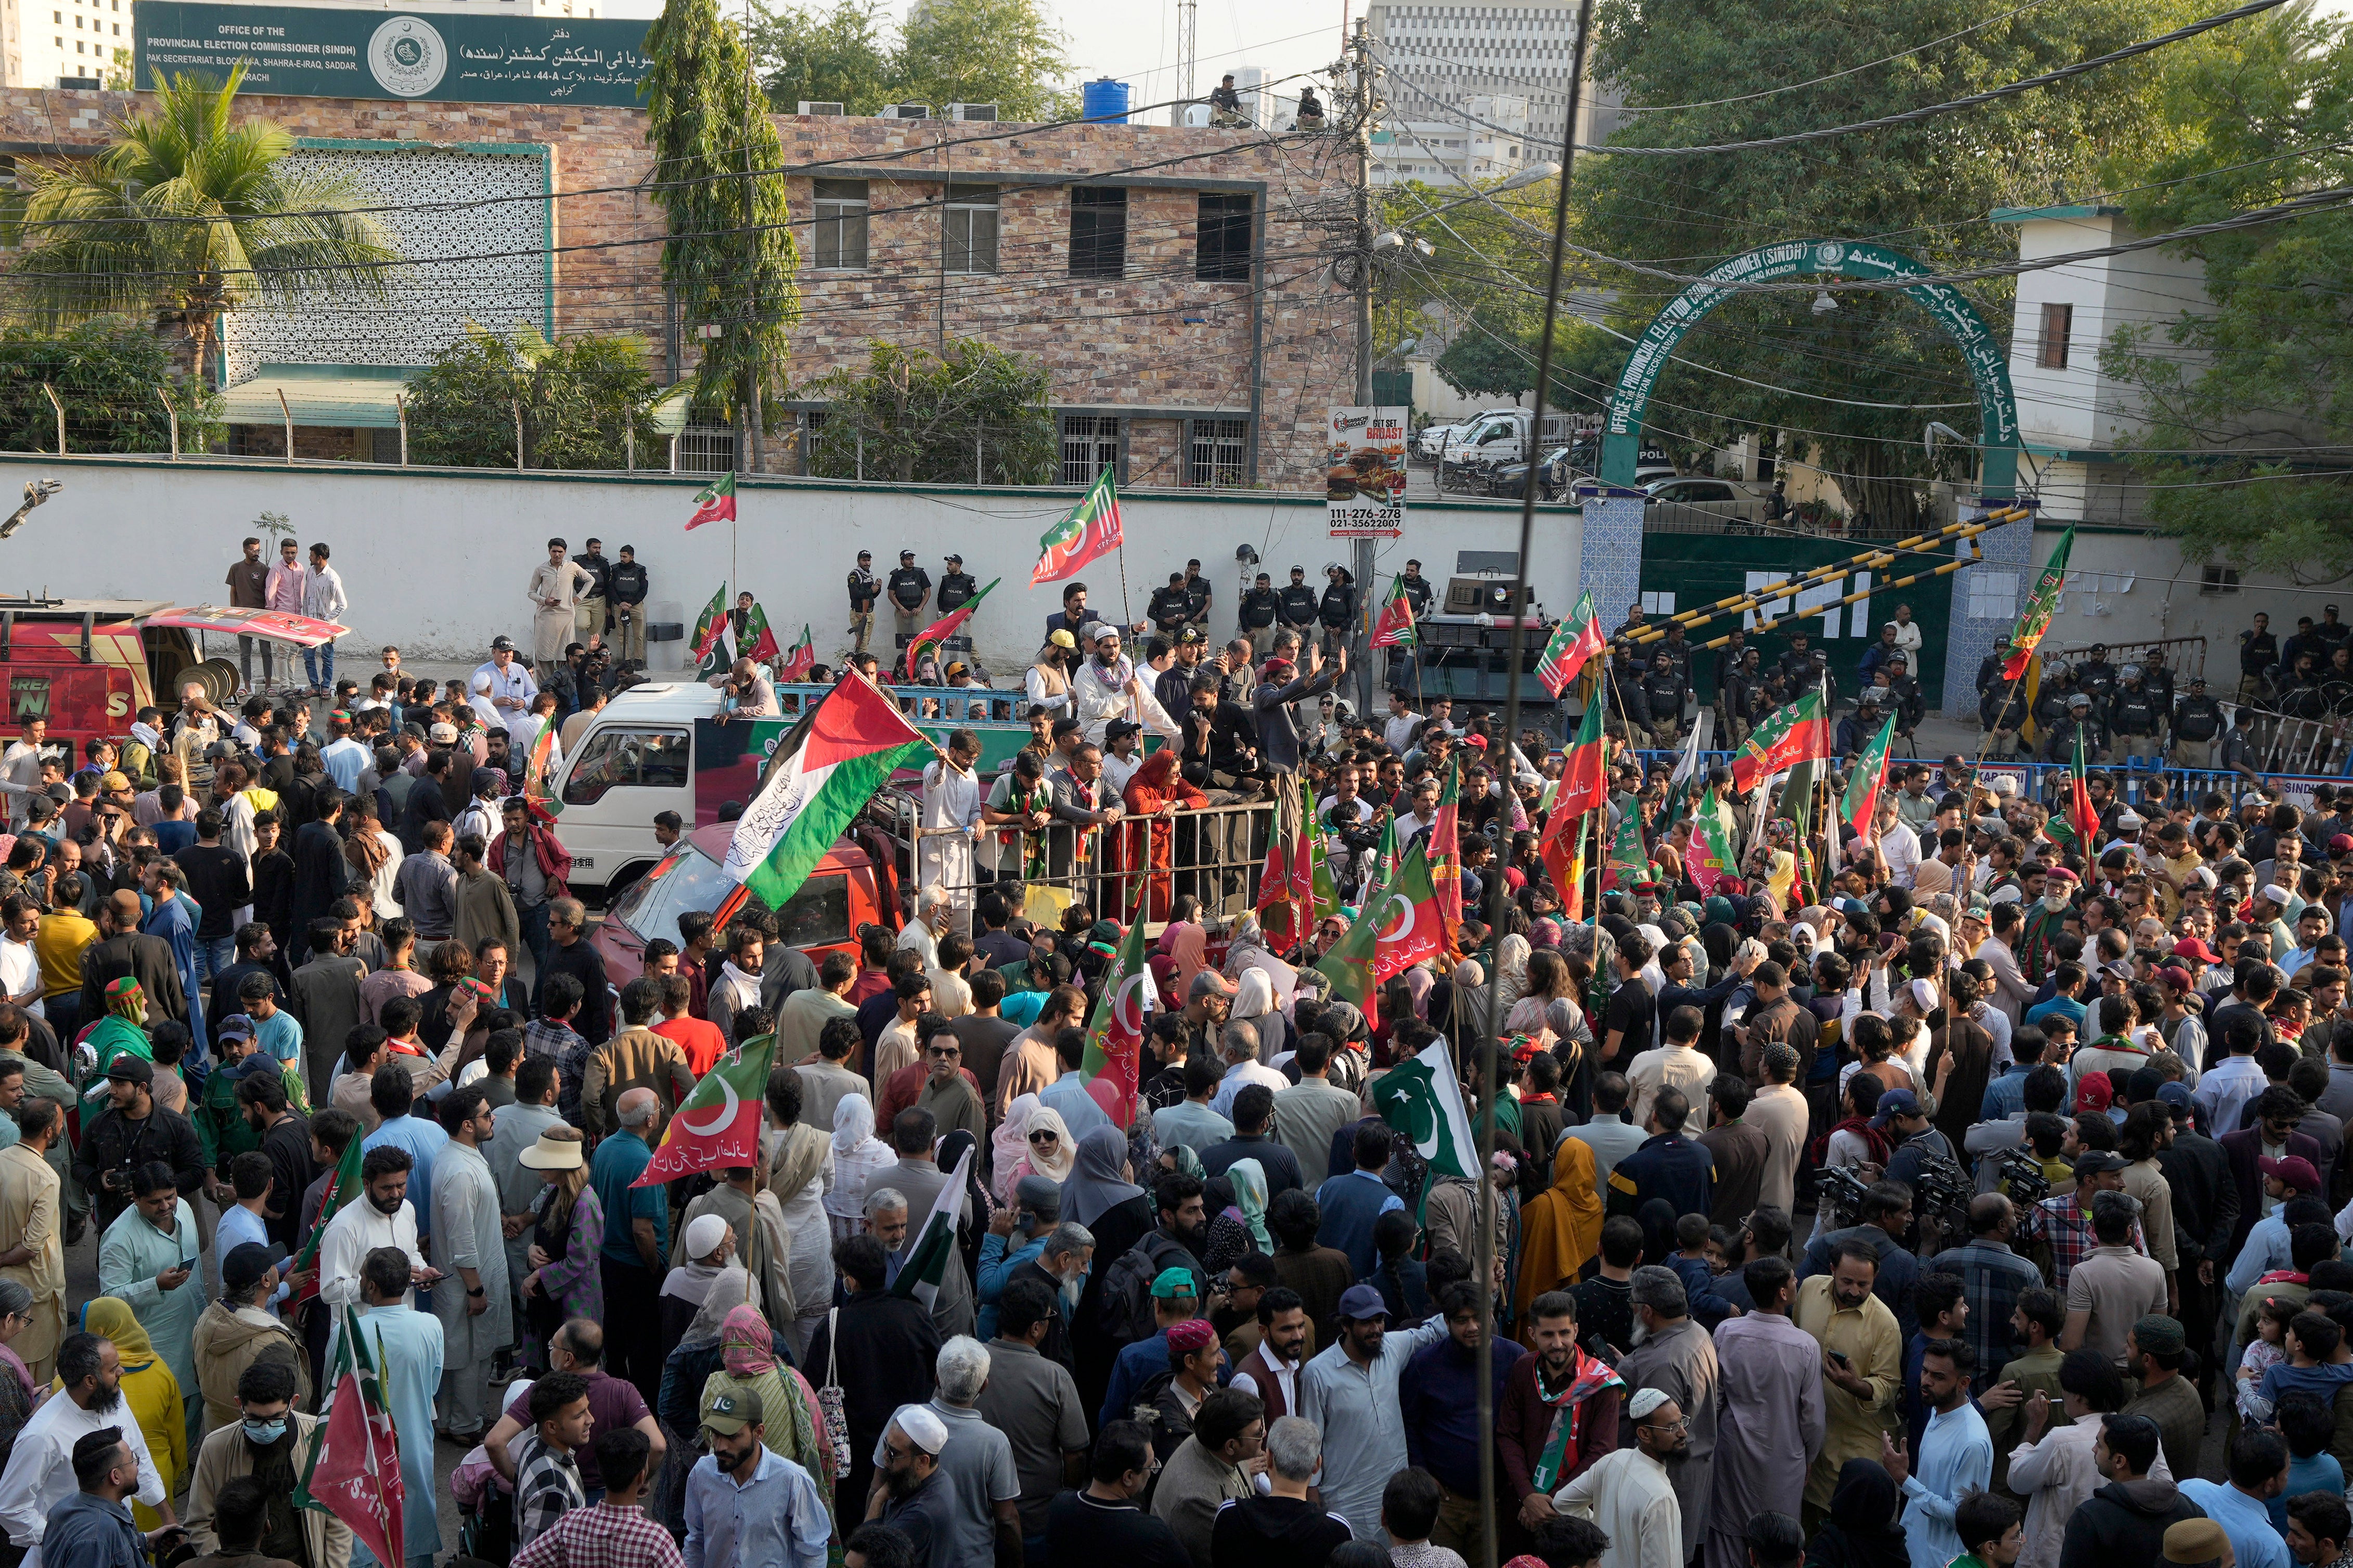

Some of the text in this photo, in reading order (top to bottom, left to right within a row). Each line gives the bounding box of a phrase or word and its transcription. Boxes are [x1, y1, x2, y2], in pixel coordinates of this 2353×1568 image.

[218, 25, 285, 36] OFFICE OF THE
[550, 28, 570, 41] دفتر
[147, 37, 356, 57] PROVINCIAL ELECTION COMMISSIONER (SINDH)
[146, 54, 161, 62] PAK
[163, 55, 214, 65] SECRETARIAT,
[216, 56, 242, 65] BLOCK
[263, 58, 323, 70] SHAHRA-E-IRAQ,
[325, 61, 357, 71] SADDAR,
[460, 70, 478, 79] صدر
[550, 83, 577, 97] کراچی
[1611, 399, 1631, 434] OFFICE
[1622, 339, 1660, 390] PROVINCIAL
[1762, 241, 1808, 267] (SINDH)
[1632, 377, 1652, 412] PAKISTAN
[1646, 330, 1679, 377] SECRETARIAT
[1765, 263, 1797, 278] KARACHI
[1346, 416, 1369, 424] KARACHI
[1386, 419, 1397, 427] SET
[1367, 427, 1403, 439] BROAST
[1639, 450, 1667, 460] POLI
[1330, 509, 1401, 519] 111-276-278
[1330, 520, 1401, 528] 021-35622007
